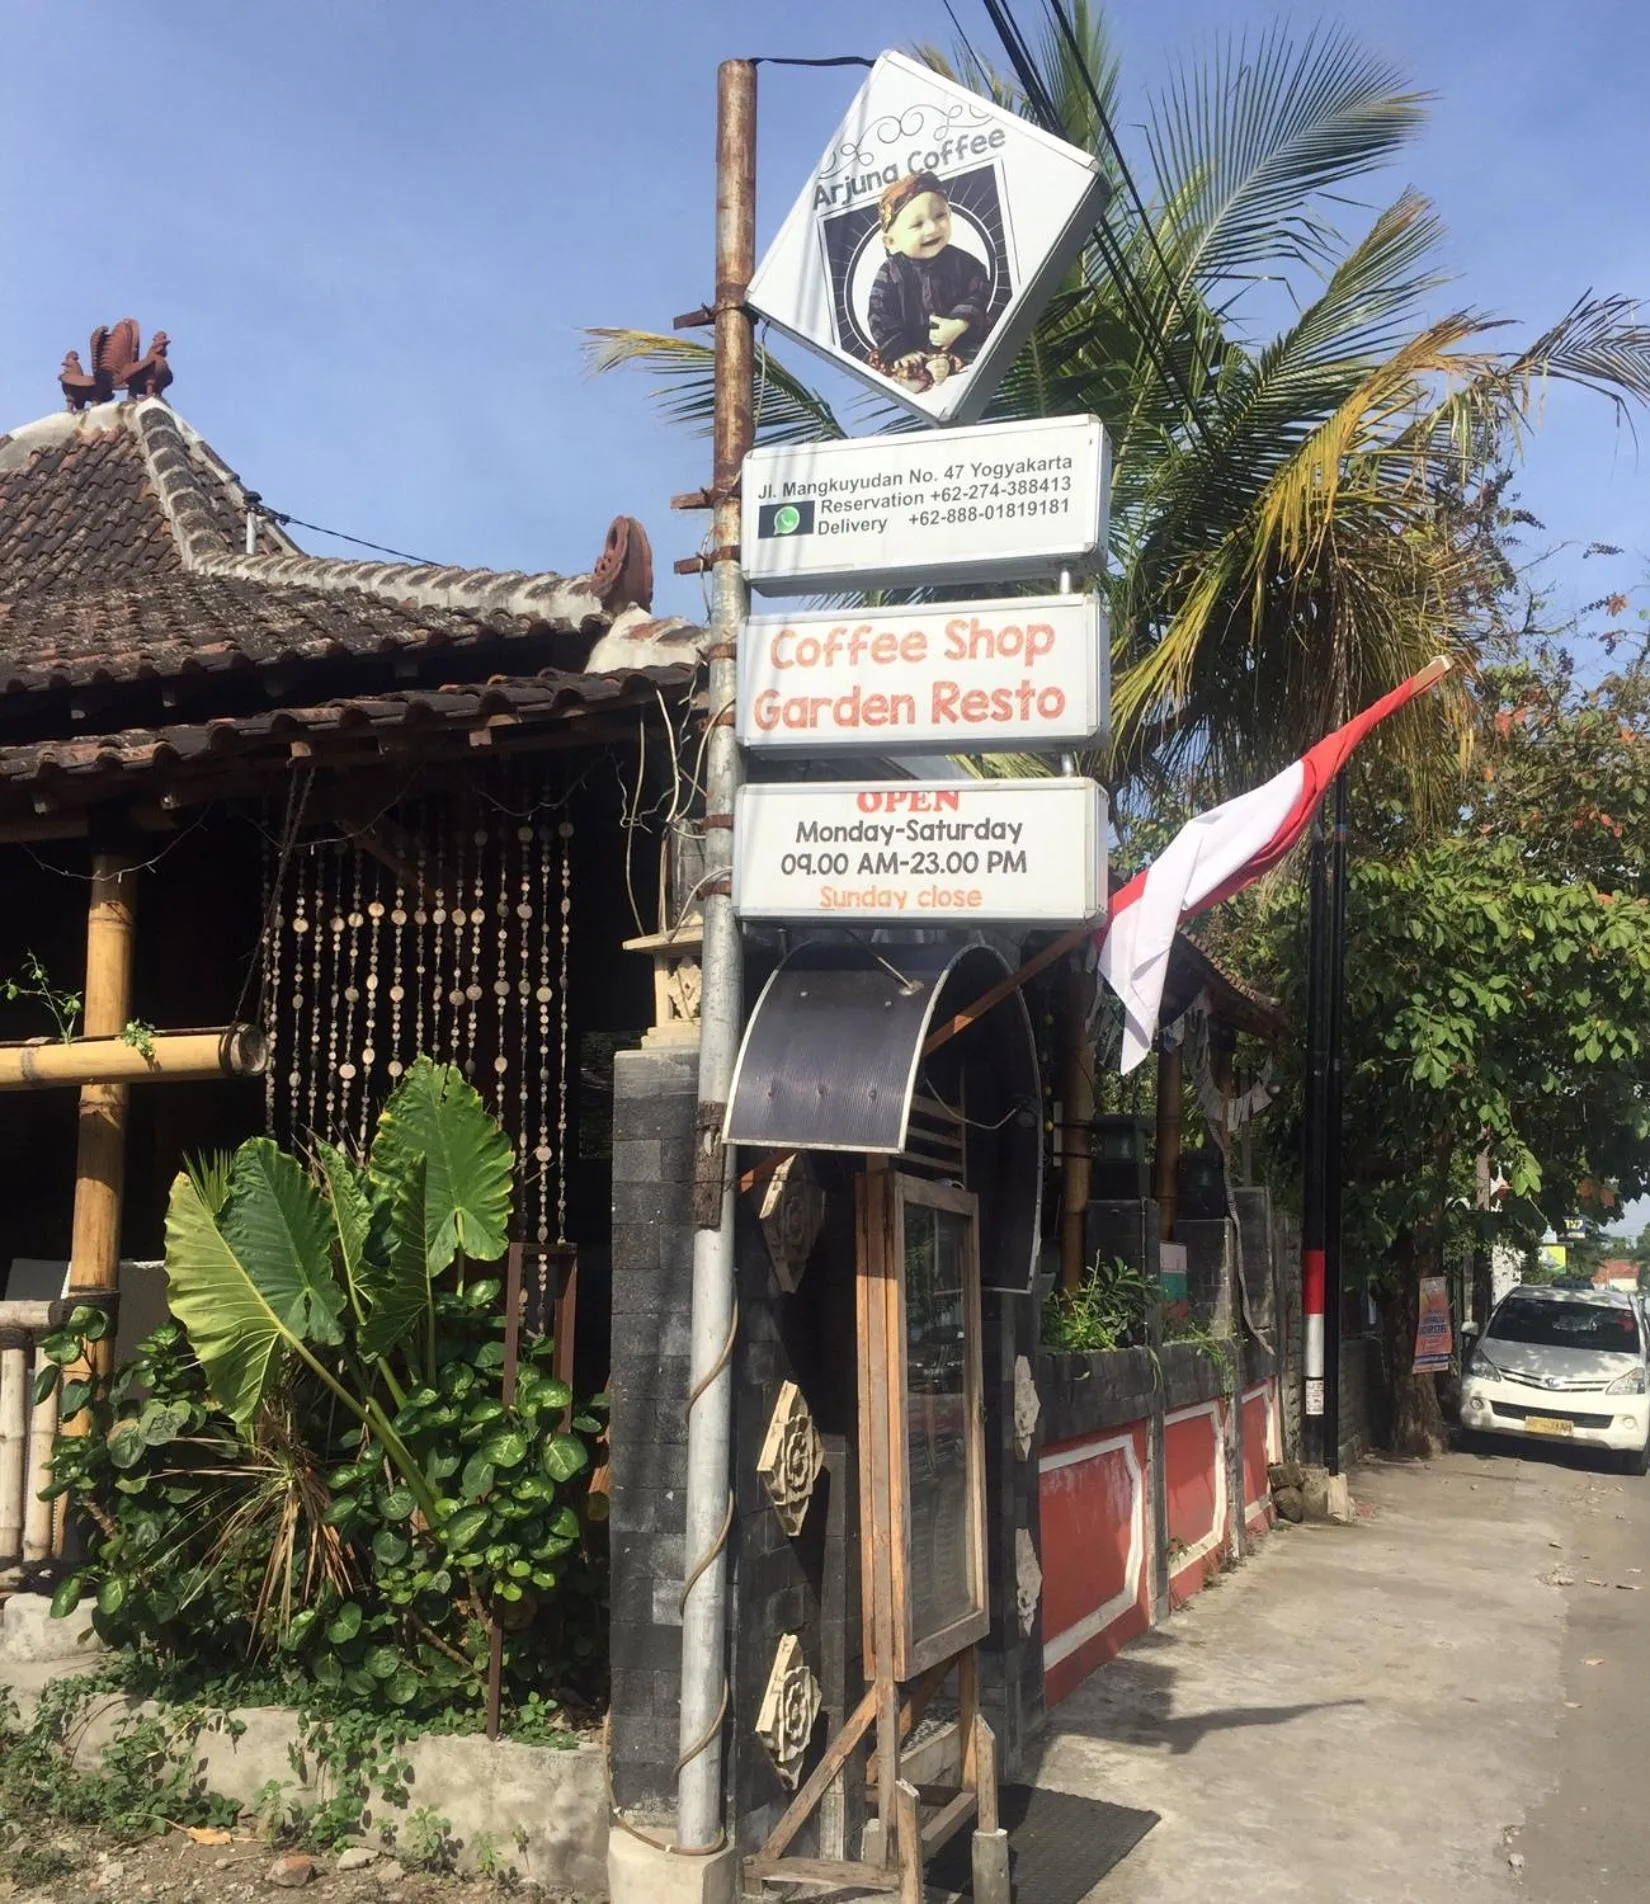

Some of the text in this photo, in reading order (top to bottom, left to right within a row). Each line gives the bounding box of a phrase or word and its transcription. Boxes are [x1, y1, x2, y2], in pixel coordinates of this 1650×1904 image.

[812, 128, 1006, 211] Arjuna Coffee
[783, 474, 903, 497] Mangkuyudan
[909, 468, 939, 484] No.
[944, 464, 964, 480] 47
[970, 455, 1073, 480] Yogyakarta
[820, 476, 1071, 514] Reservation +62-274-388413
[818, 500, 1069, 535] Delivery +62-888-01819181
[769, 618, 1056, 670] Coffee Shop
[754, 680, 1066, 731] Garden Resto
[856, 790, 960, 813] OPEN
[795, 818, 1023, 845] Monday-Saturday
[780, 851, 1028, 876] 09.00 AM-23.00 PM
[819, 885, 983, 909] Sunday close
